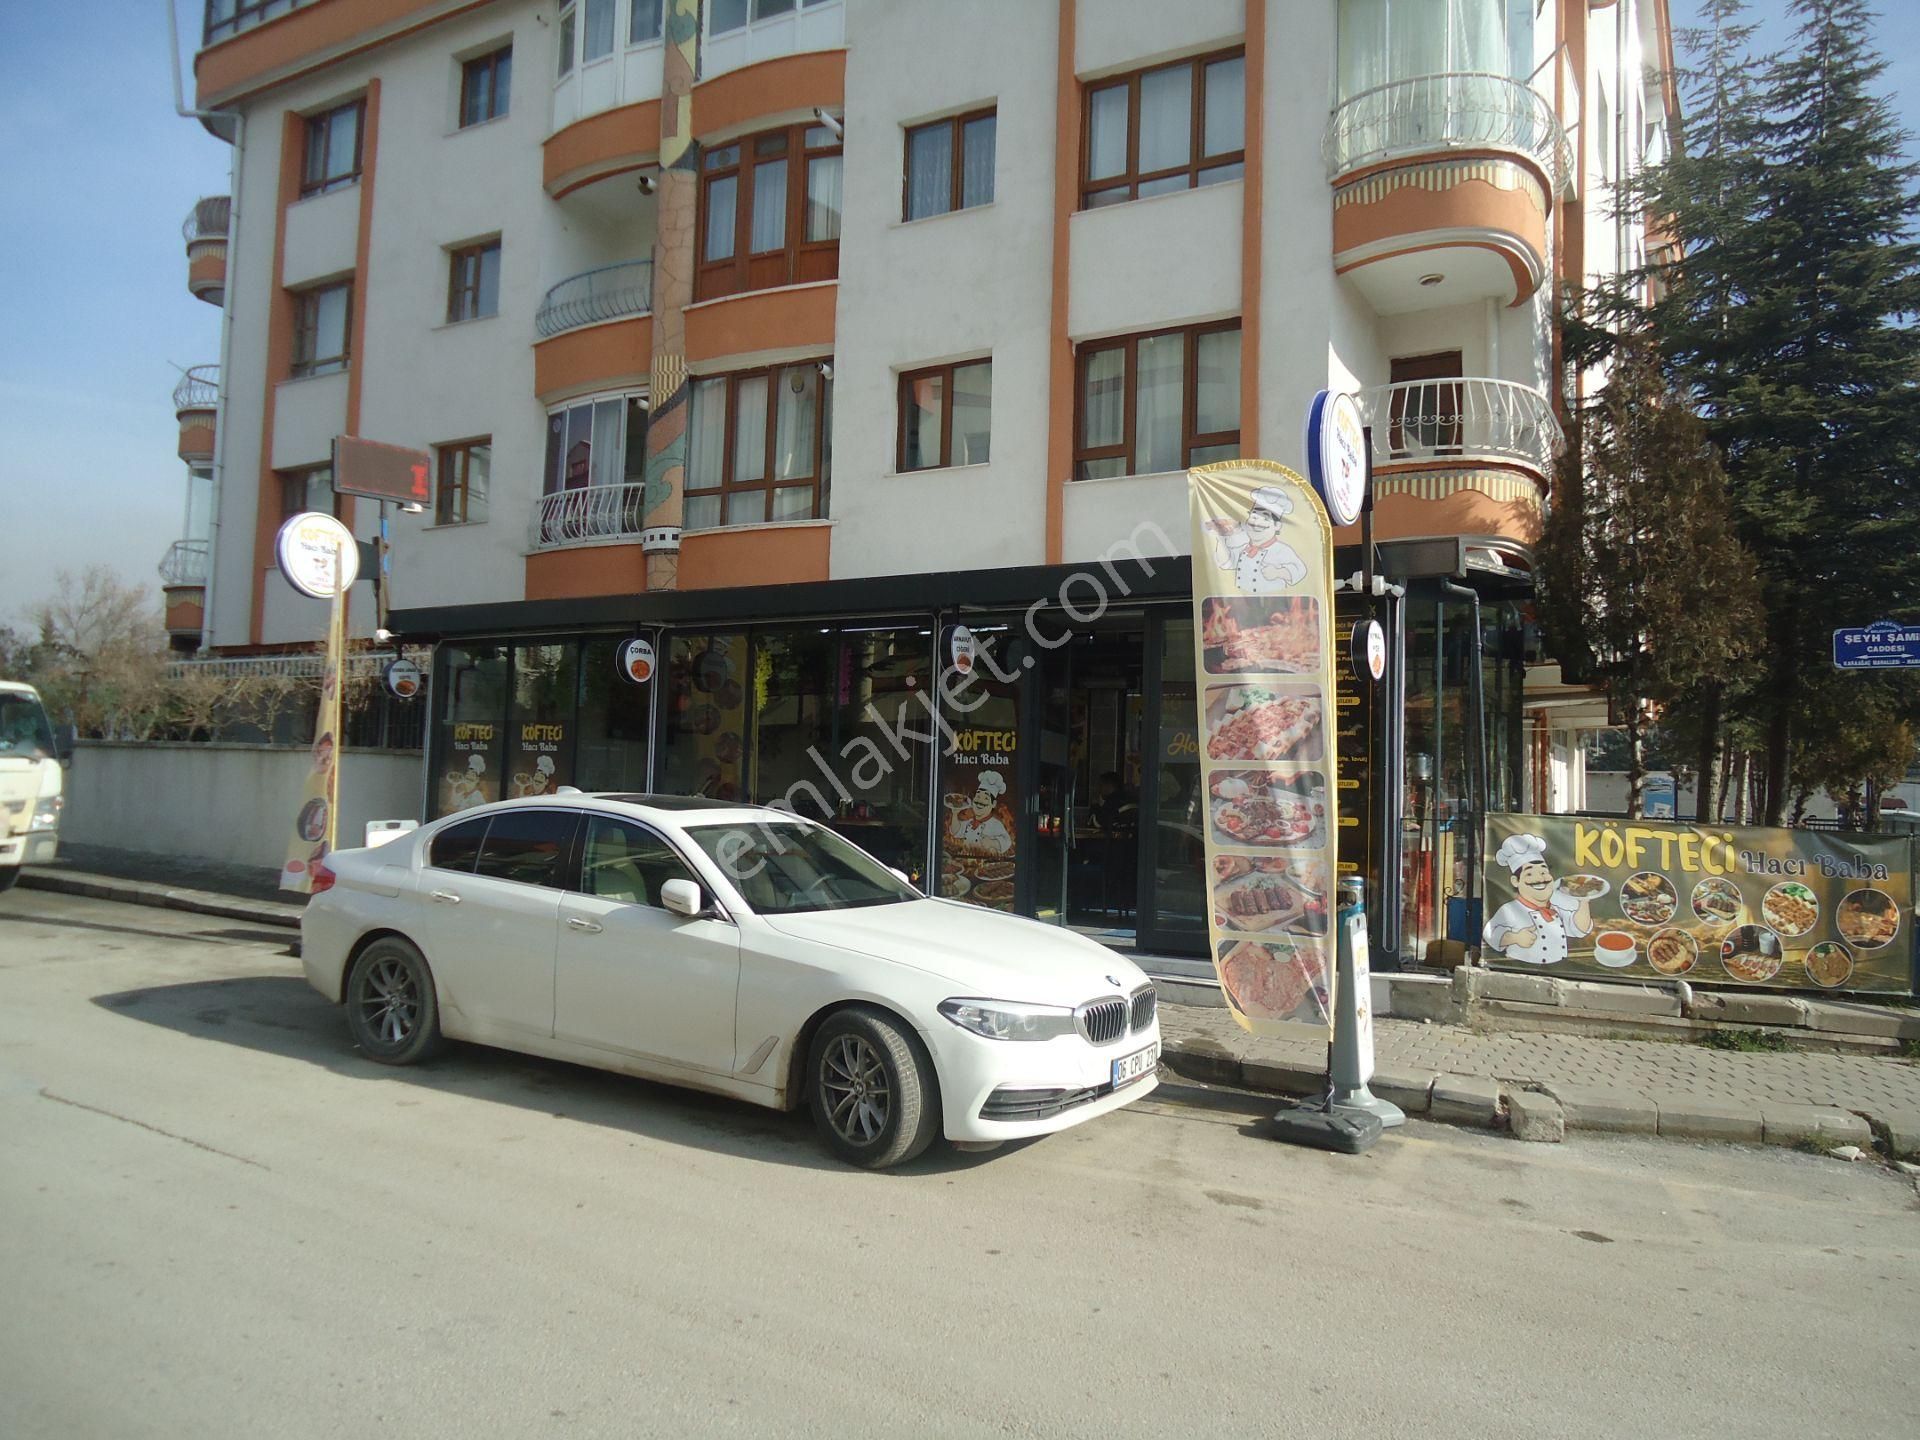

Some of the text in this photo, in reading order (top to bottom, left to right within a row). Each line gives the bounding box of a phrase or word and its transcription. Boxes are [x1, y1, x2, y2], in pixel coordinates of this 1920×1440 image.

[1844, 634, 1881, 645] ŞEYH
[630, 647, 652, 655] ÇORBA
[1867, 645, 1905, 653] CADDESİ
[454, 723, 493, 740] KÖFTECİ
[522, 723, 562, 741] KÖFTECİ
[953, 728, 1016, 752] KÖFTECİ
[471, 742, 488, 751] Baba
[522, 742, 557, 752] Hacı Baba
[954, 753, 1009, 765] Hacı Baba
[1575, 821, 1736, 876] KÖFTECİ
[1741, 850, 1889, 881] Hacı Baba
